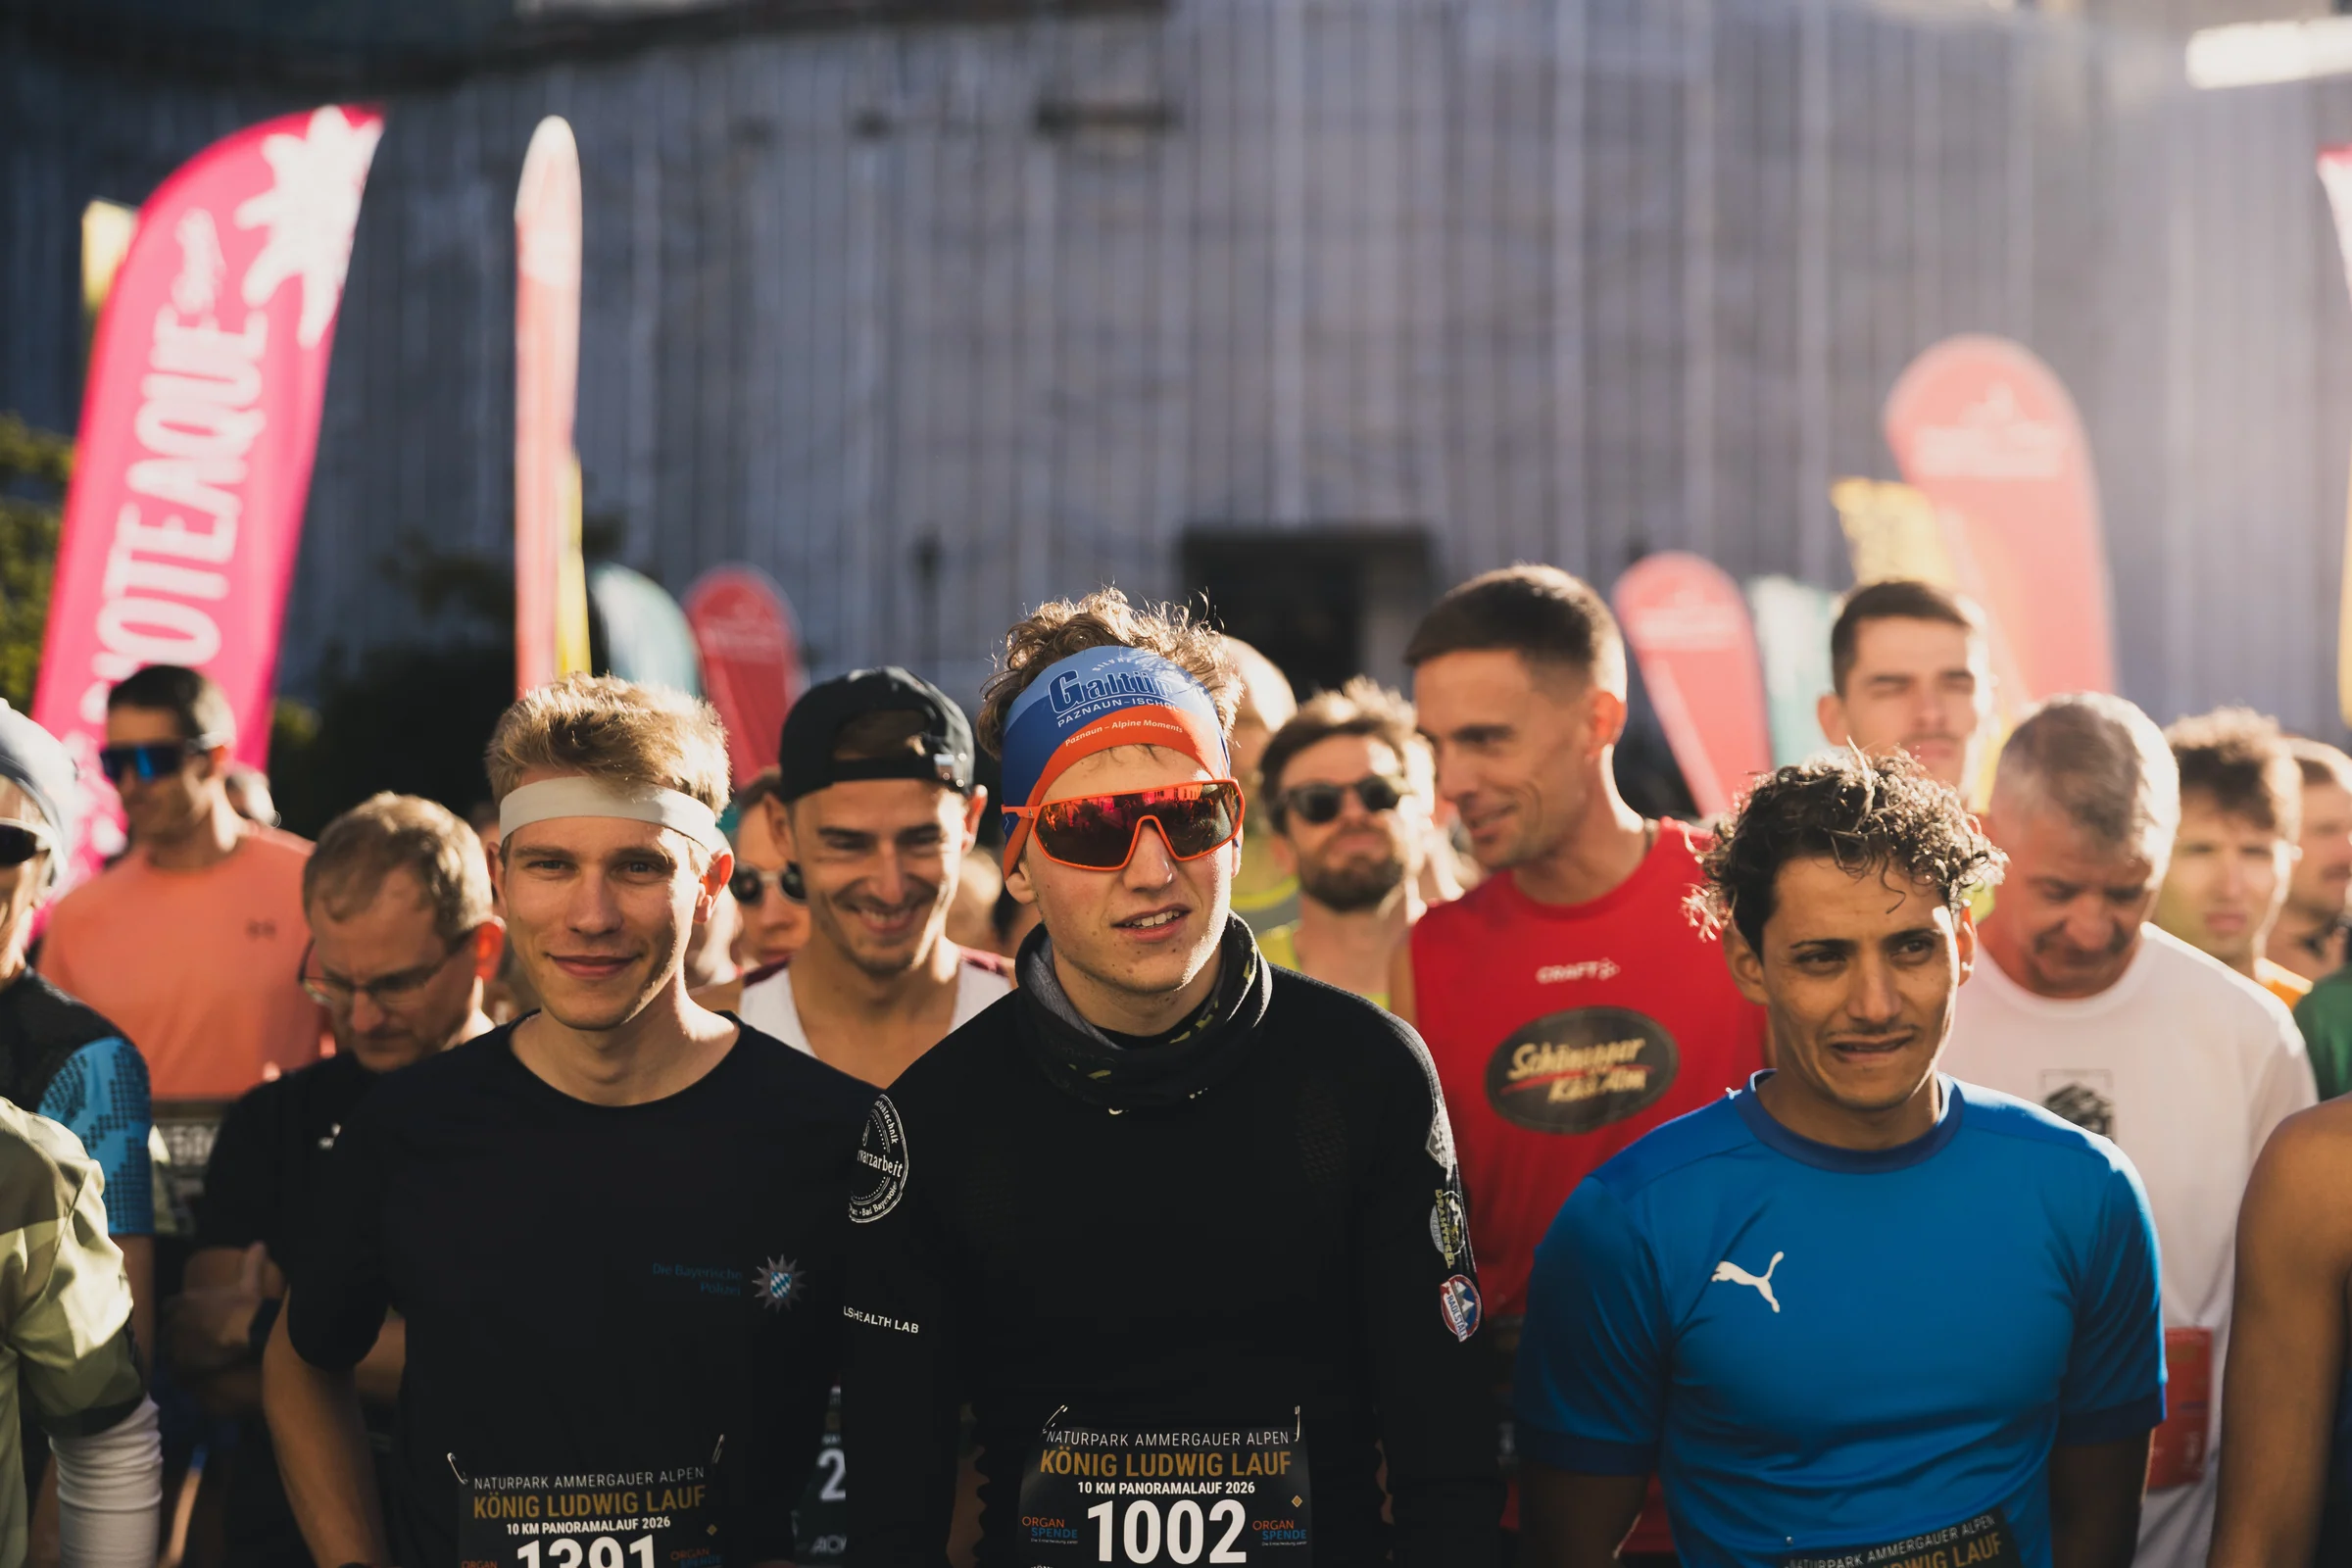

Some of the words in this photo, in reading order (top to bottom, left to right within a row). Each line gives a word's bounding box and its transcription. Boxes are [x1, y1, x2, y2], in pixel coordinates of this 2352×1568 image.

[1065, 726, 1102, 747] Paznaun
[1111, 719, 1141, 730] Alpine
[1143, 719, 1183, 733] Moments
[652, 1262, 672, 1276] Die
[674, 1262, 743, 1281] Bayerische
[699, 1281, 742, 1297] Polizei
[894, 1319, 919, 1334] LAB
[1047, 1431, 1129, 1446] NATURPARK
[1135, 1432, 1241, 1446] AMMERGAUER
[1246, 1431, 1289, 1445] ALPEN
[1040, 1446, 1117, 1477] KÖNIG
[1127, 1452, 1223, 1477] LUDWIG
[1231, 1451, 1292, 1477] LAUF
[474, 1474, 549, 1490] NATURPARK
[554, 1472, 654, 1489] AMMERGAUER
[660, 1467, 705, 1483] ALPEN
[1078, 1481, 1092, 1494] 10
[1096, 1482, 1115, 1494] KM
[1118, 1481, 1223, 1494] PANORAMALAUF
[1225, 1481, 1255, 1494] 2026
[473, 1492, 539, 1519] KÖNIG
[546, 1491, 639, 1518] LUDWIG
[646, 1485, 706, 1512] LAUF
[507, 1523, 518, 1535] 10
[521, 1522, 539, 1535] KM
[542, 1518, 639, 1535] PANORAMALAUF
[642, 1516, 670, 1530] 2026
[1021, 1516, 1065, 1529] ORGAN
[1252, 1520, 1295, 1531] ORGAN
[1031, 1527, 1078, 1540] SPENDE
[1088, 1499, 1247, 1565] 1002
[1262, 1530, 1306, 1541] SPENDE
[1867, 1526, 1959, 1563] AMMERGAUER
[1961, 1513, 1995, 1537] ALPEN
[670, 1547, 710, 1561] ORGAN
[1951, 1532, 2001, 1568] LAUF
